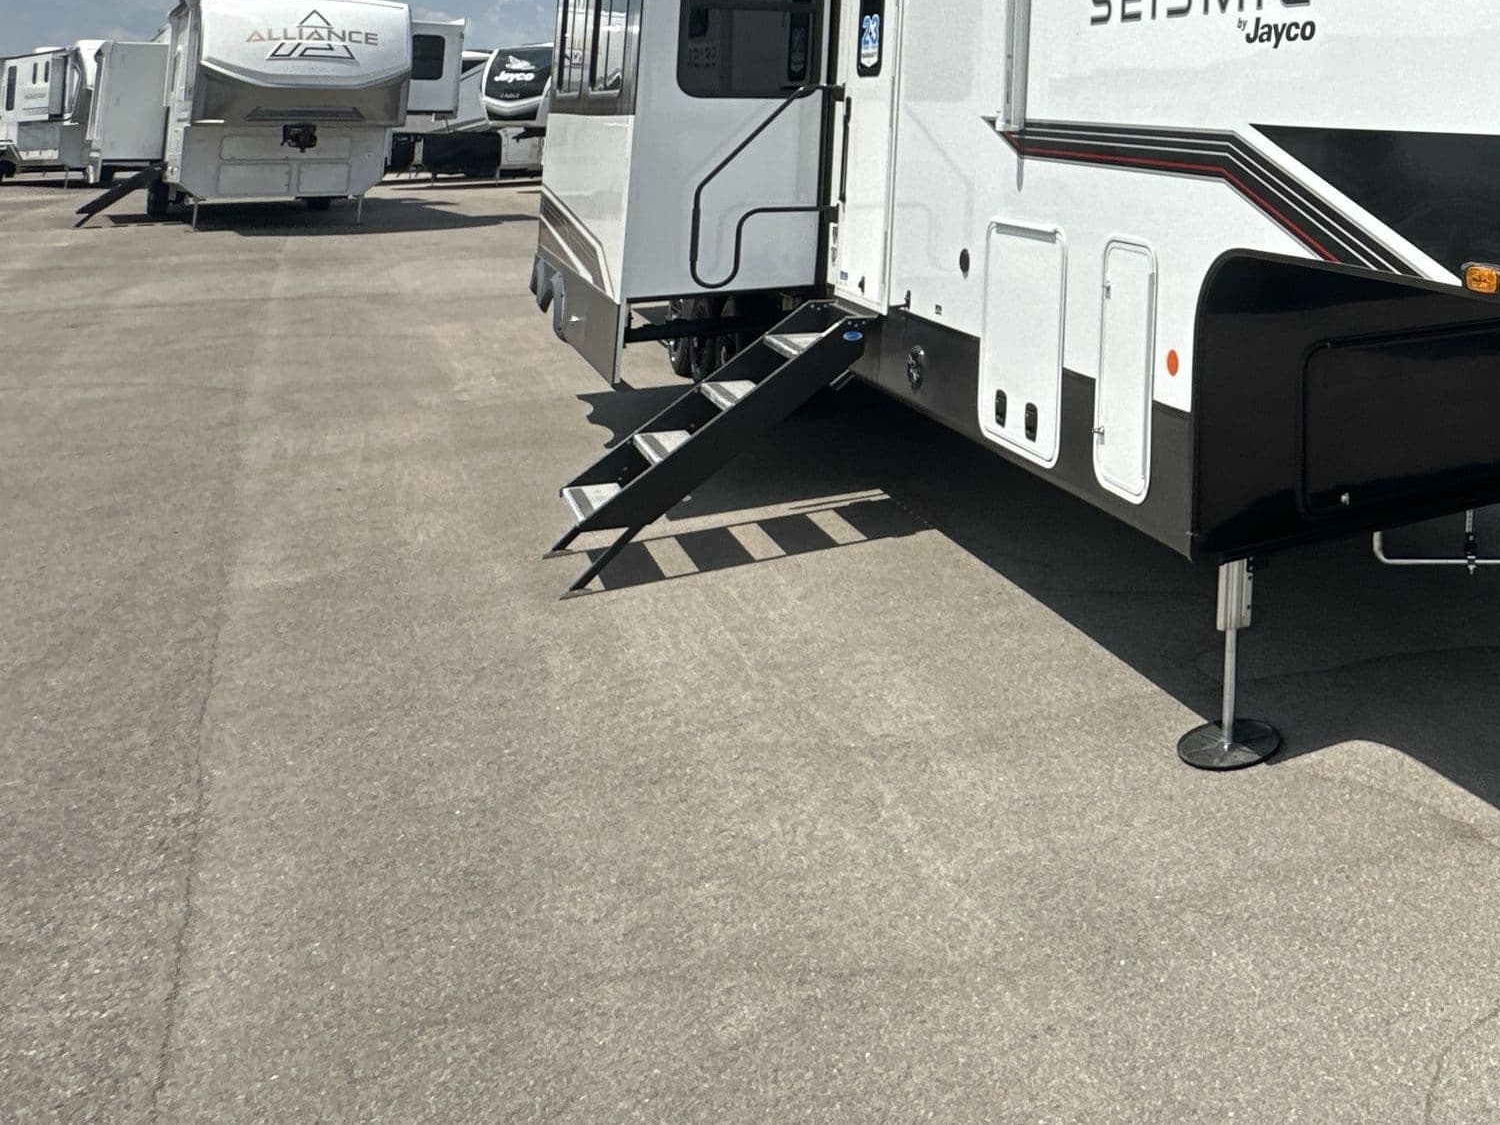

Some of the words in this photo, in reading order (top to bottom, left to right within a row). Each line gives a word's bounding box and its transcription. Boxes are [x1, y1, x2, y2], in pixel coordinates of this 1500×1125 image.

[245, 27, 378, 46] ALLIANCE
[1237, 17, 1248, 31] by
[1245, 16, 1316, 49] Jayco
[494, 70, 535, 83] Jayco
